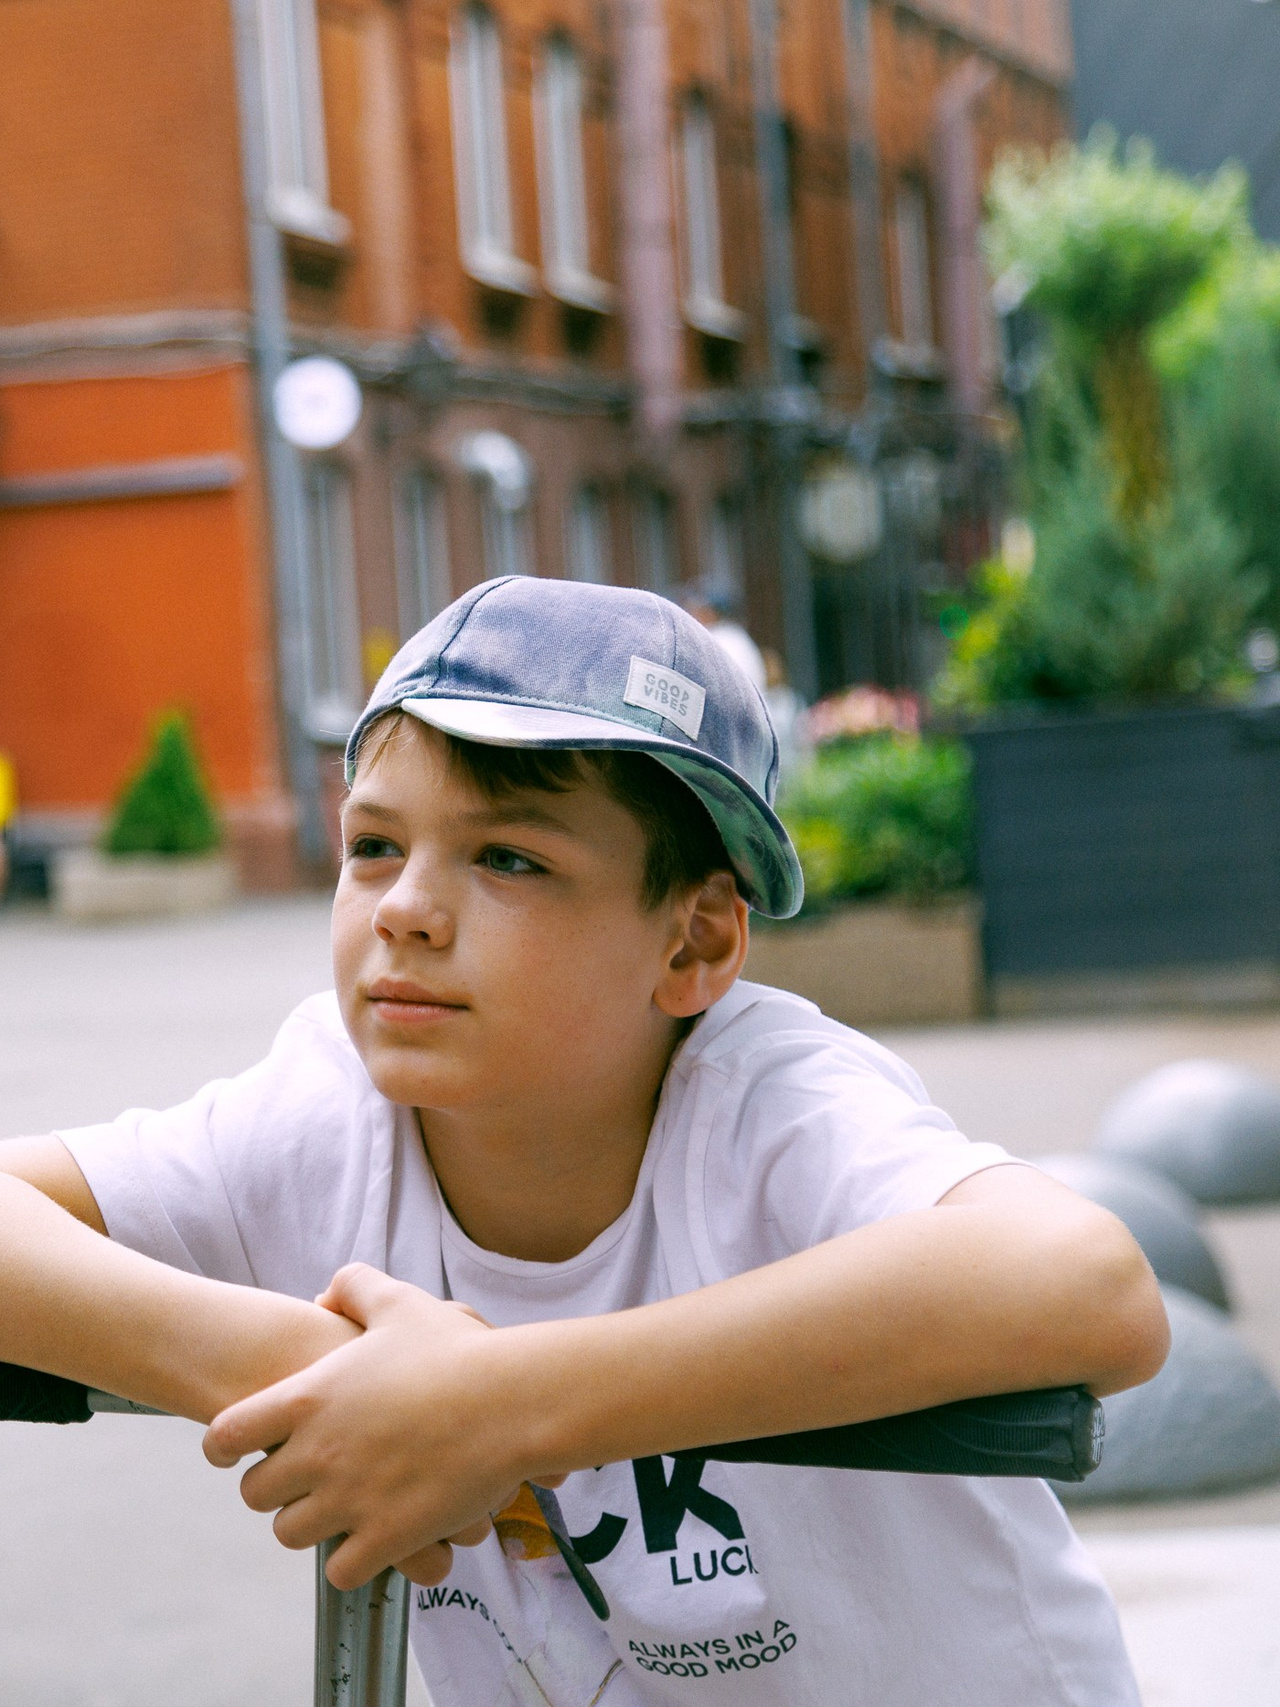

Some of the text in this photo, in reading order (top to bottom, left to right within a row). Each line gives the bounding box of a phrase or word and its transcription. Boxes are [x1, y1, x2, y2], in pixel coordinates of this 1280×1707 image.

[644, 685, 688, 716] VIBES
[646, 673, 689, 701] GOOD
[628, 1619, 790, 1659] ALWAYS IN A
[636, 1632, 798, 1678] GOOD MOOD
